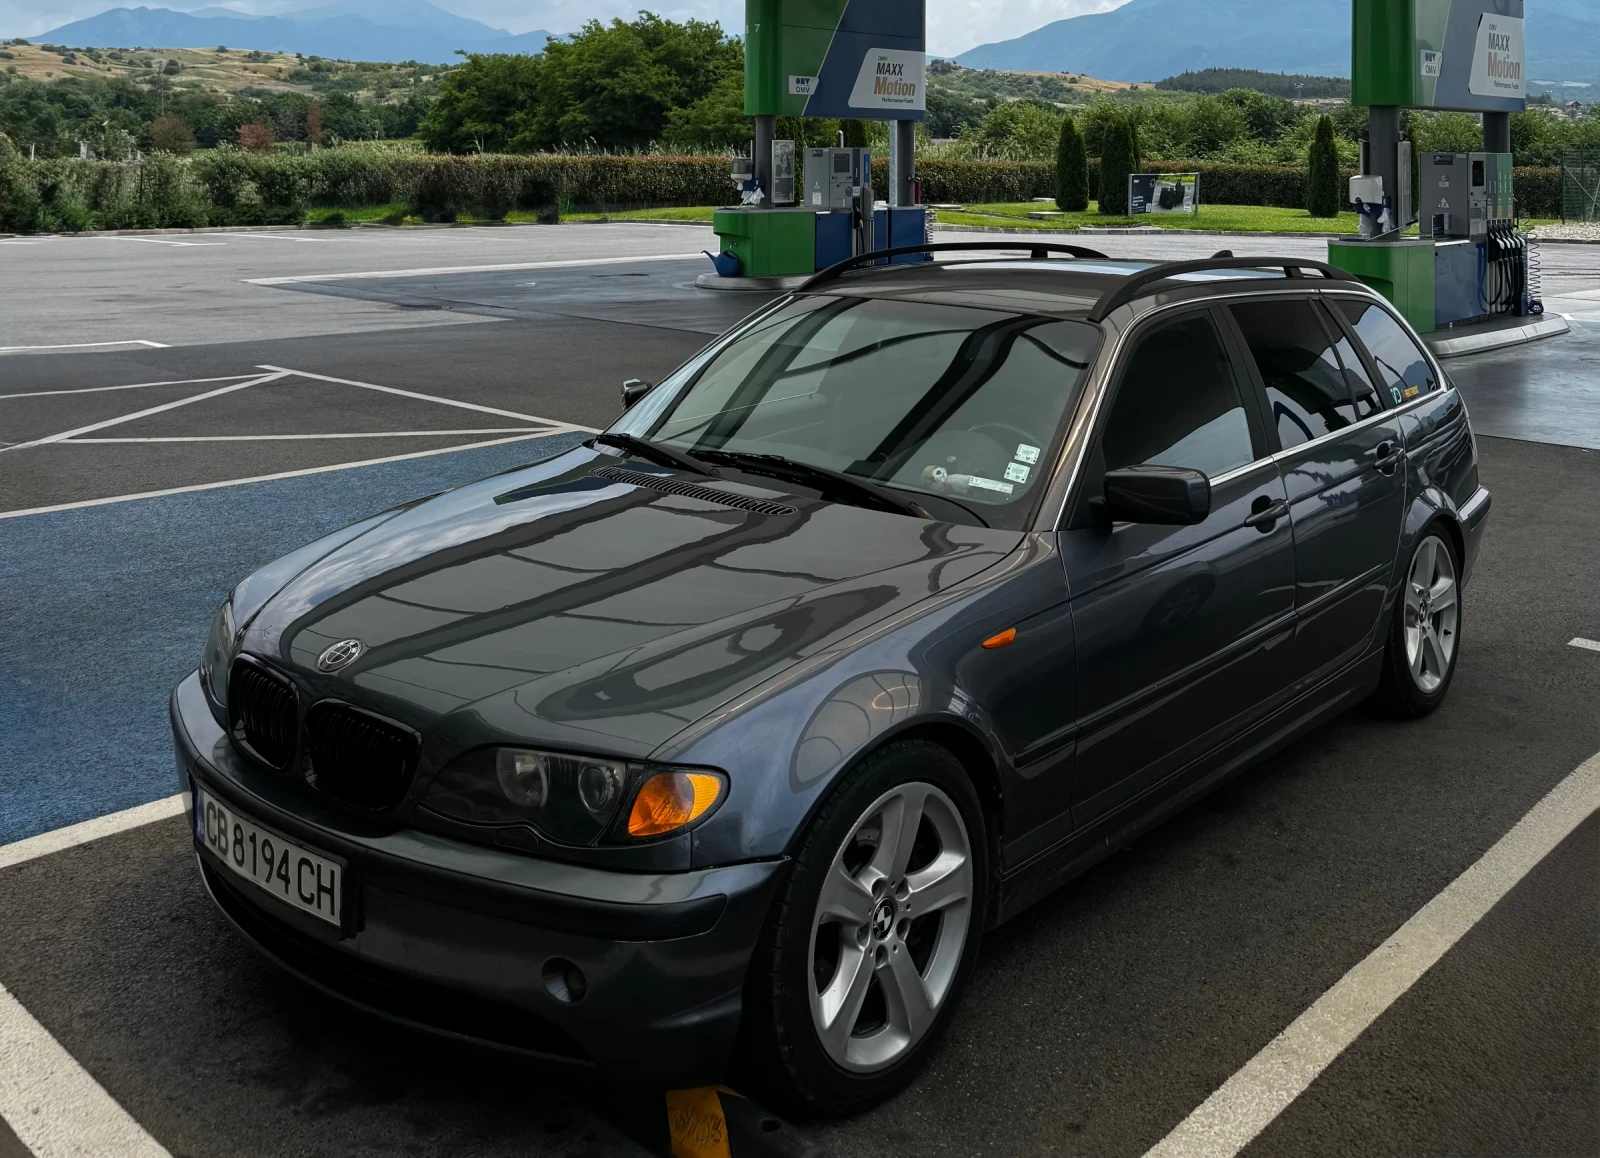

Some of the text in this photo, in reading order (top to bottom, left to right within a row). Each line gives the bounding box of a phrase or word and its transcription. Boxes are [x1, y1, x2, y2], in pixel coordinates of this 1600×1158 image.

[754, 23, 761, 33] 7
[1488, 32, 1511, 52] MAXX
[876, 62, 904, 76] MAXX
[1487, 52, 1521, 80] Motion
[873, 76, 916, 96] Motion
